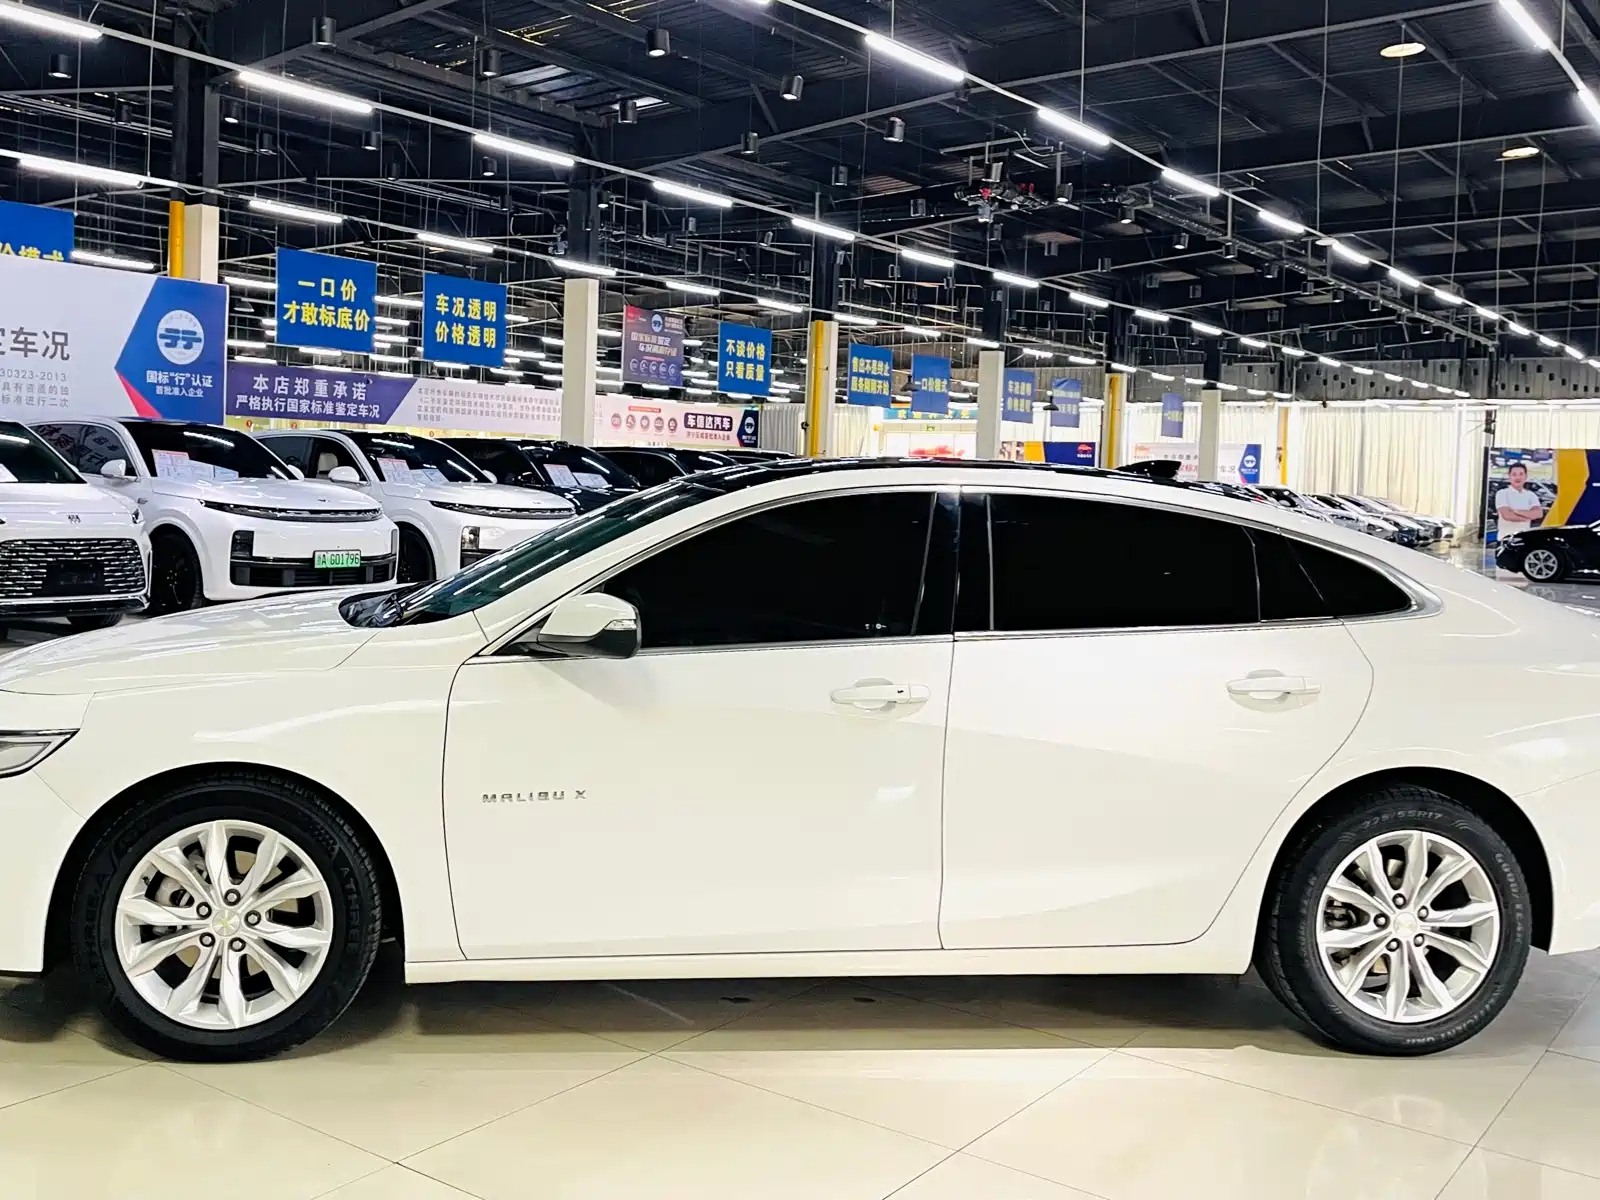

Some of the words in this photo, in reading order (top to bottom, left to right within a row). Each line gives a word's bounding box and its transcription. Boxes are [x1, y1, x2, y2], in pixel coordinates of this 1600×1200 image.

[298, 278, 357, 302] 一口价
[283, 301, 370, 332] 才敢标底价
[435, 293, 497, 322] 车况透明
[435, 321, 496, 349] 价格透明
[725, 339, 765, 361] 不谈价格
[725, 361, 765, 382] 只看质量
[156, 385, 204, 398] 首批准入企业
[253, 374, 367, 401] 本店郑重承诺
[235, 394, 380, 419] 严格执行国家标准鉴定车况
[687, 414, 731, 430] 车信达汽车
[482, 791, 565, 803] MALIBU
[574, 789, 587, 800] X
